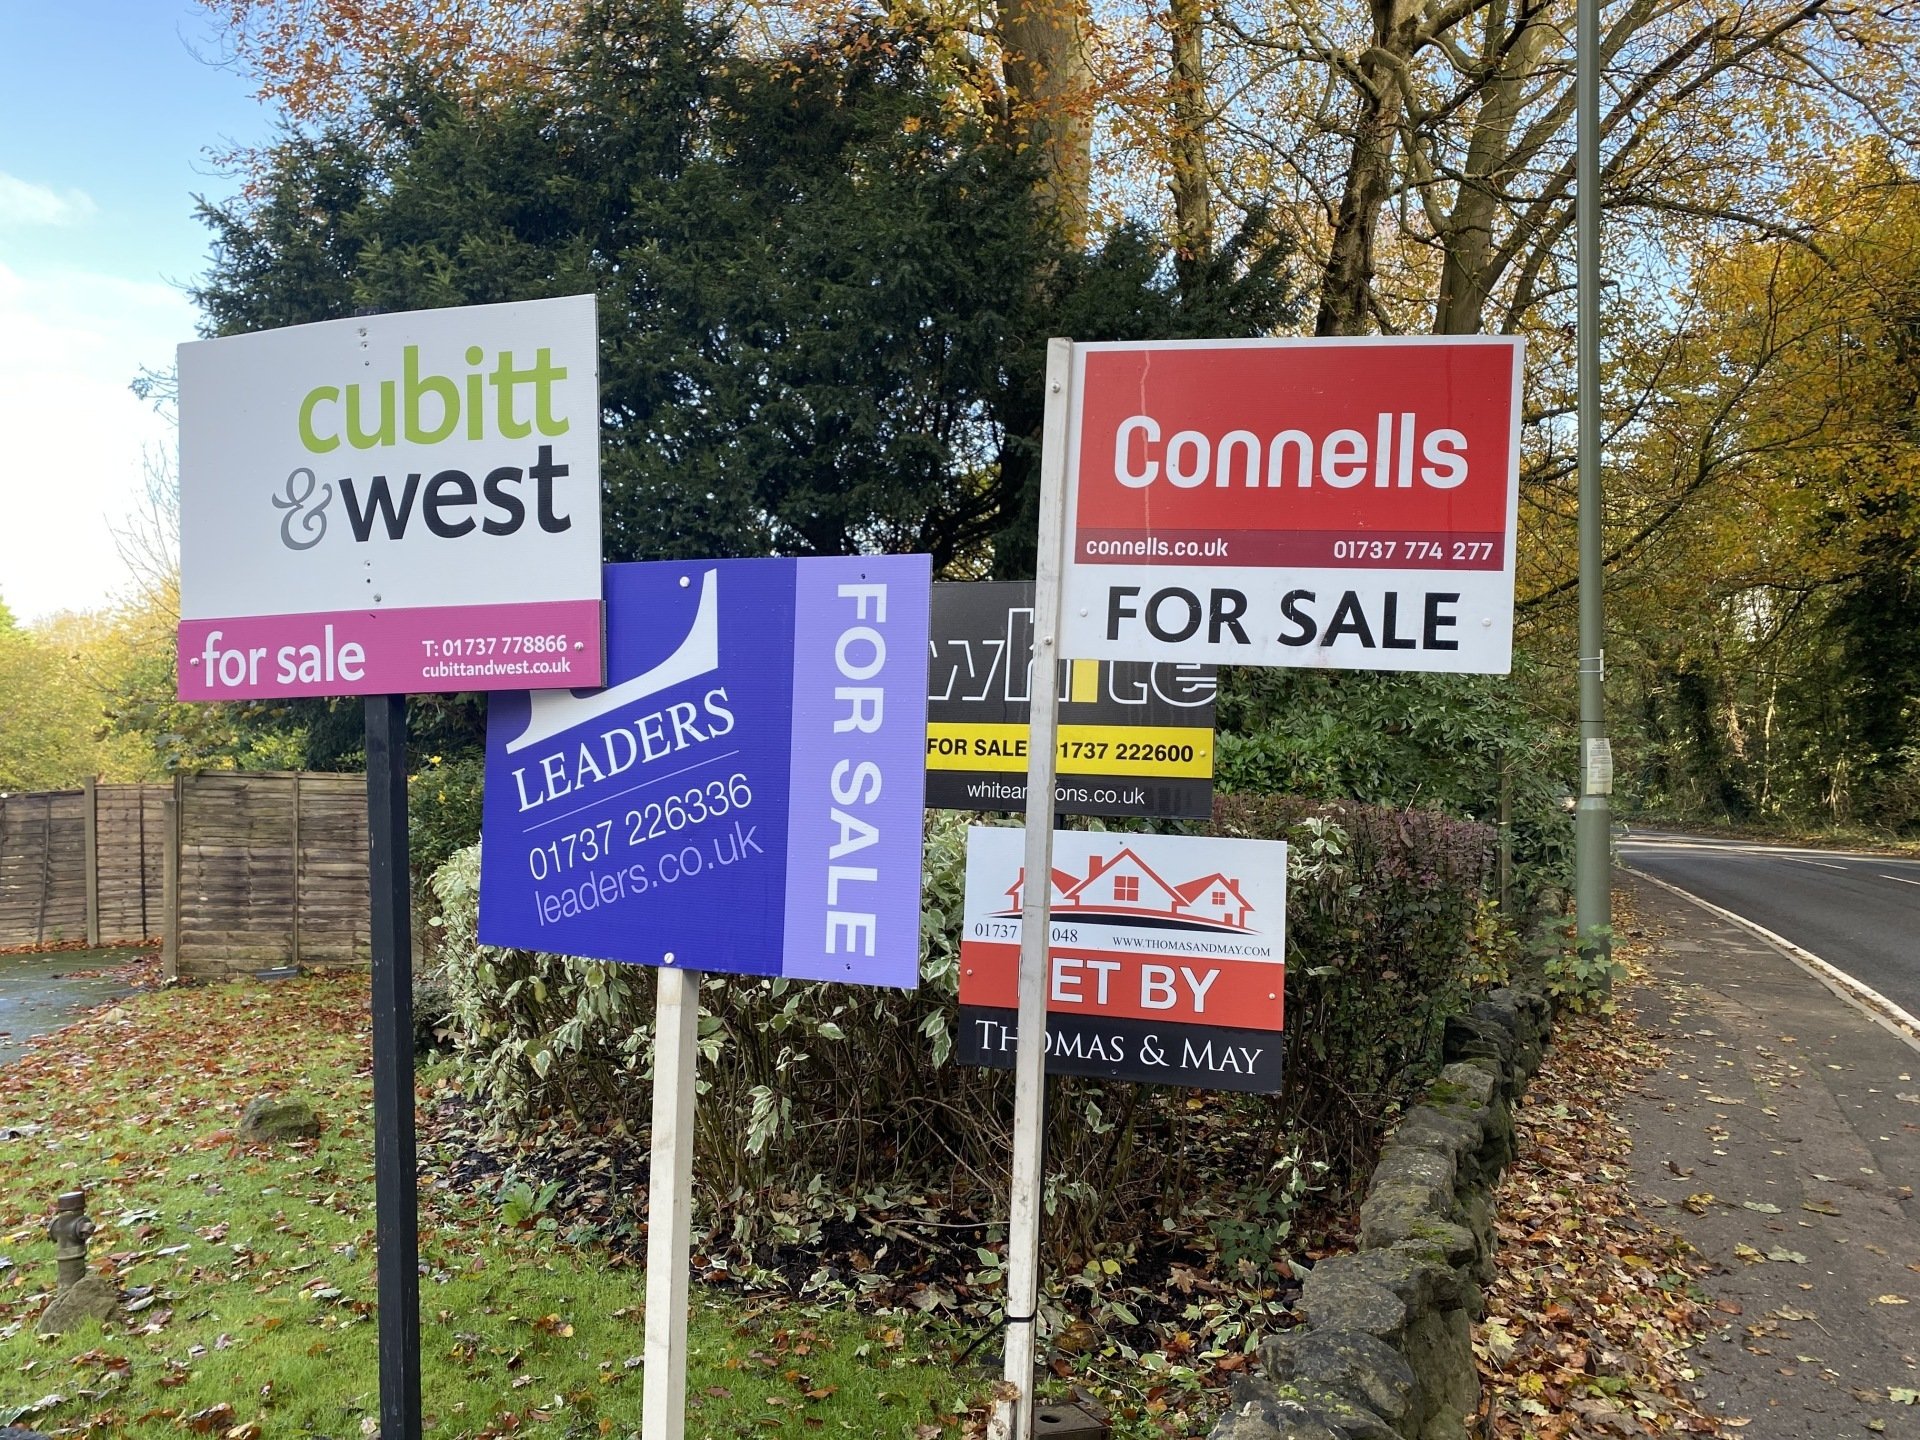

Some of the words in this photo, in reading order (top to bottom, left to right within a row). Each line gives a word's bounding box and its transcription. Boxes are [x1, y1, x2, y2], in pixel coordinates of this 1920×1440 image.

[298, 345, 570, 454] cubitt
[1113, 412, 1469, 490] Connells
[1086, 537, 1228, 558] connells.co.uk
[1333, 540, 1396, 560] 01737
[1404, 541, 1443, 560] 774
[1452, 542, 1493, 561] 277
[442, 637, 497, 656] 01737
[502, 634, 568, 655] 778866
[1107, 586, 1251, 646] FOR
[1277, 588, 1461, 652] SALE
[202, 630, 267, 688] for
[276, 624, 366, 684] sale
[422, 656, 571, 678] cubittandwest.co.uk
[833, 582, 887, 734] FOR
[511, 686, 736, 813] LEADERS
[927, 738, 968, 755] FOR
[974, 739, 1027, 757] SALE
[1056, 742, 1109, 760] 1737
[1115, 743, 1194, 763] 222600
[528, 820, 614, 881] 01737
[624, 772, 753, 847] 226336
[825, 759, 883, 958] SALE
[535, 821, 764, 927] leaders.co.uk
[975, 923, 1018, 938] 01737
[1113, 936, 1271, 957] WWW.THOMASANDMAY.COM
[1018, 954, 1122, 1006] ET
[1140, 963, 1222, 1014] BY
[1139, 1034, 1170, 1067] &
[1179, 1037, 1264, 1075] MAY
